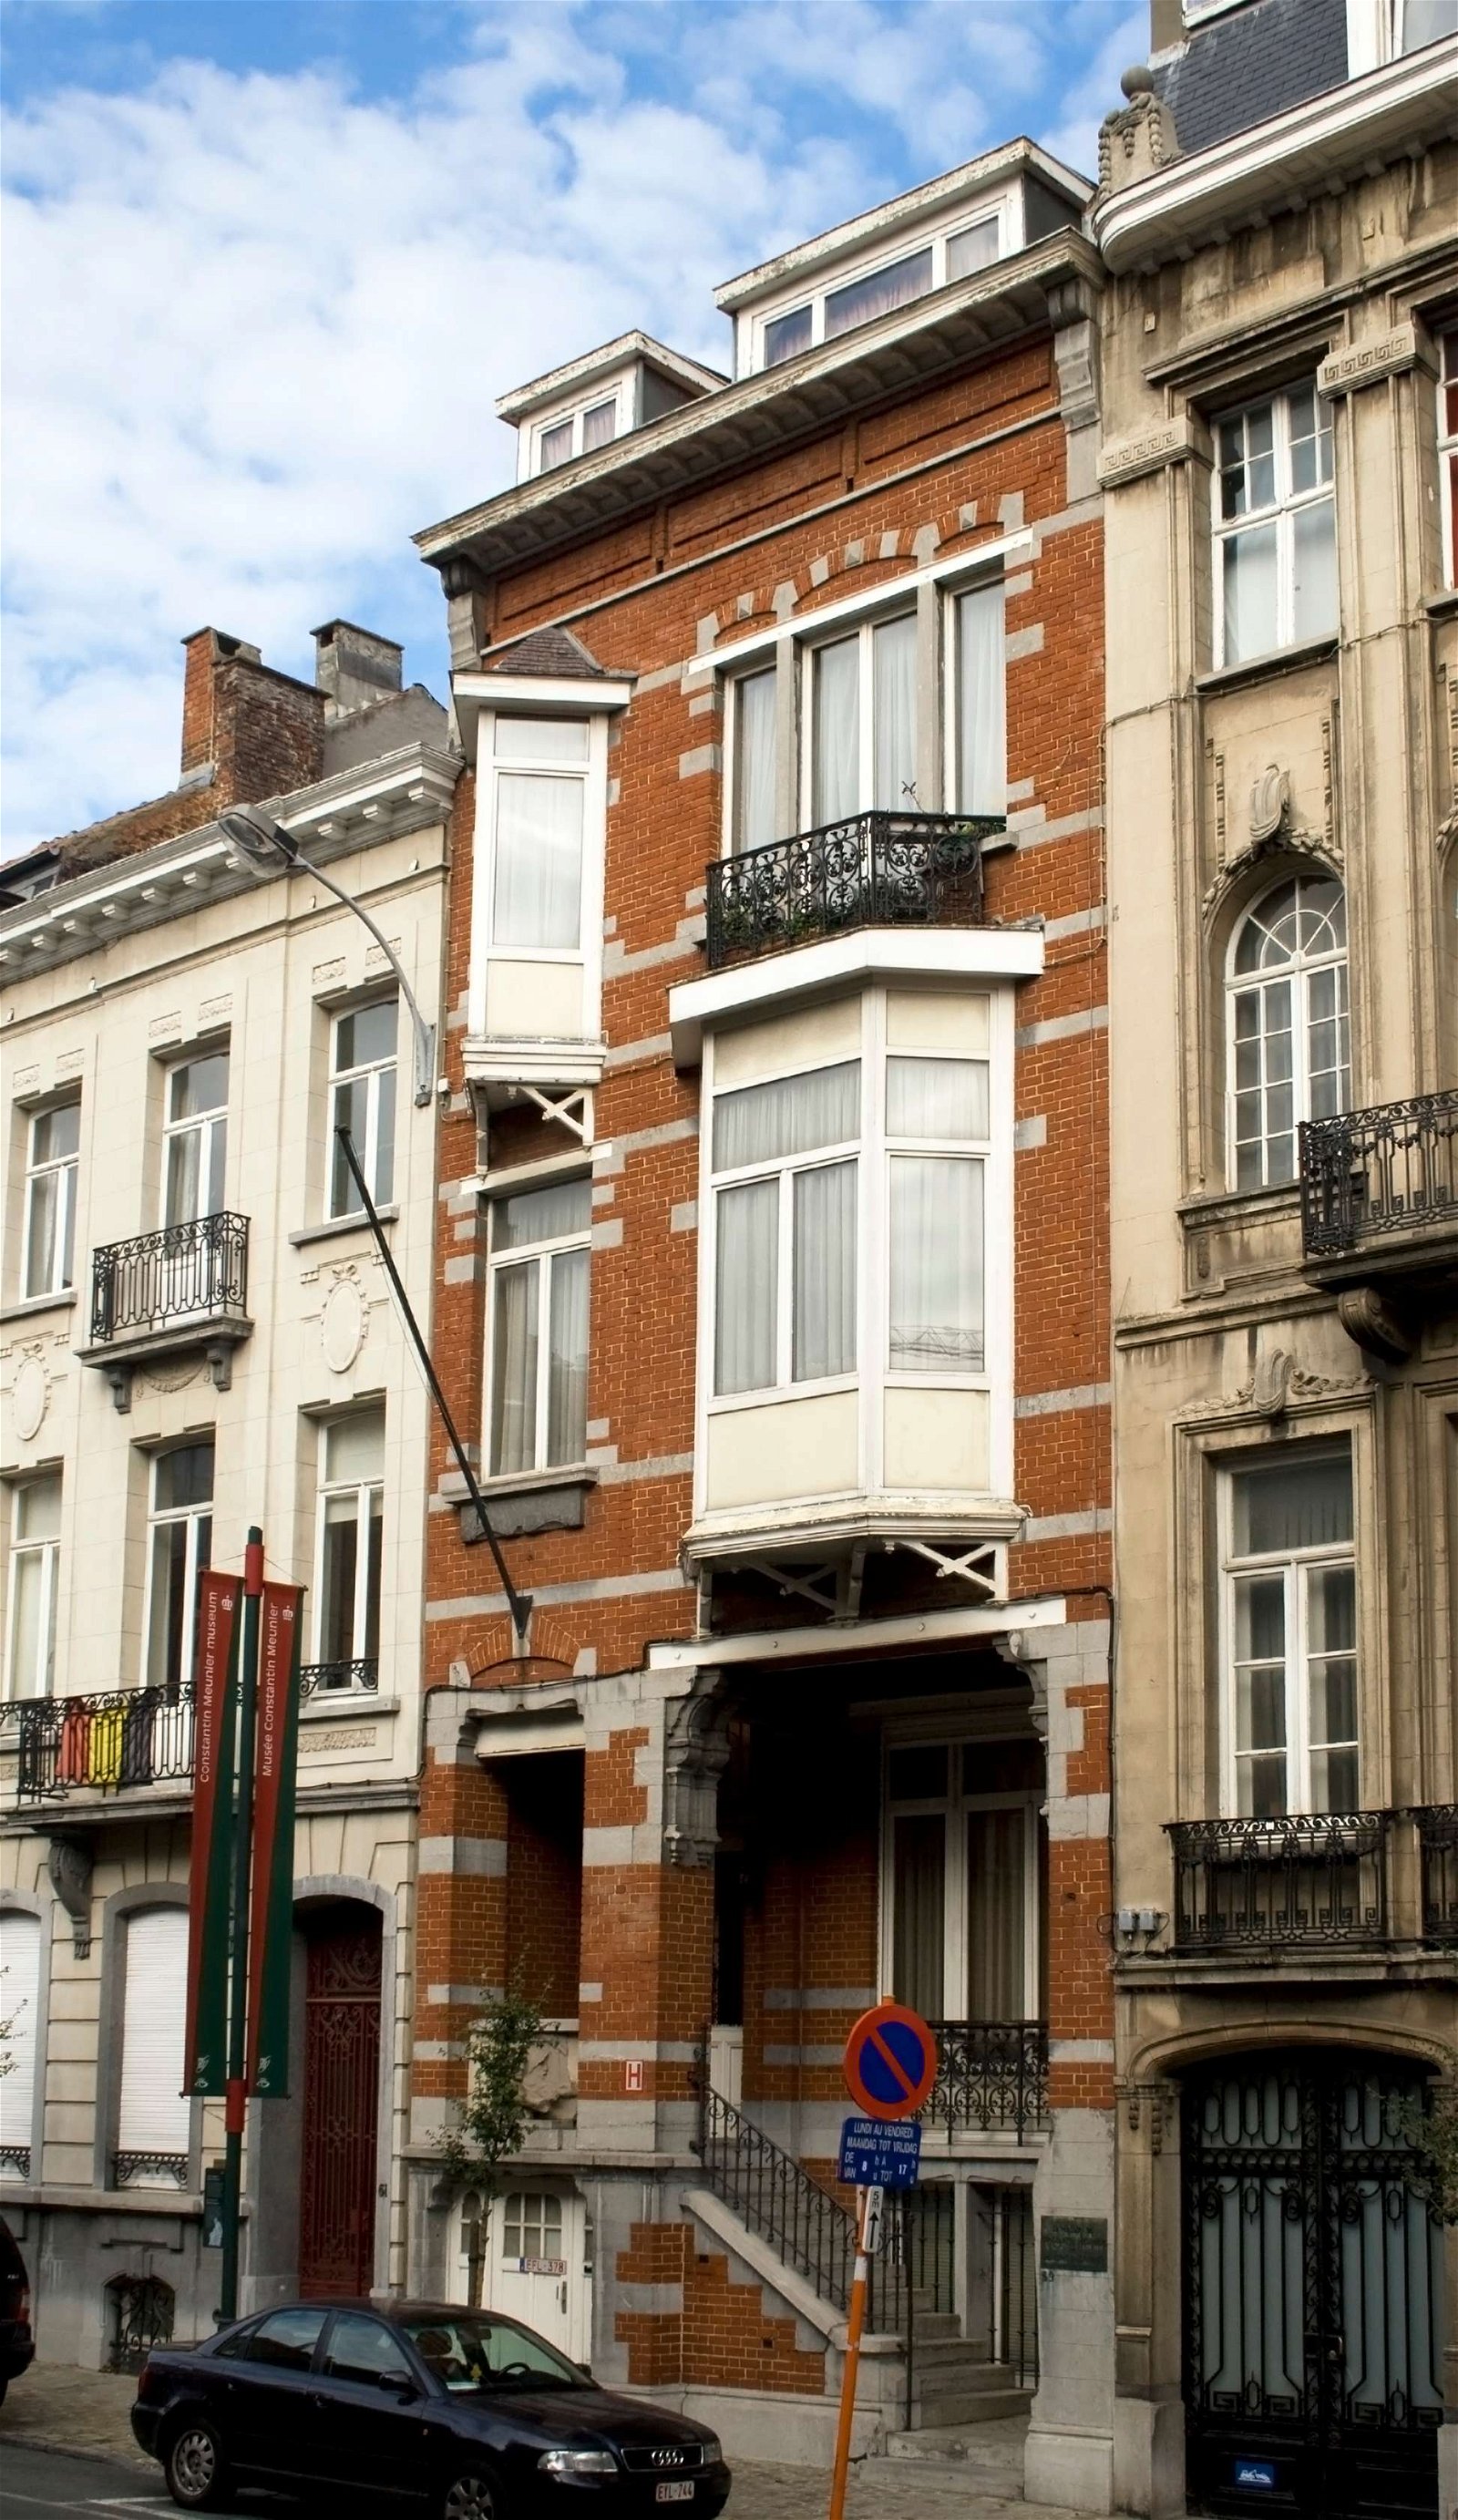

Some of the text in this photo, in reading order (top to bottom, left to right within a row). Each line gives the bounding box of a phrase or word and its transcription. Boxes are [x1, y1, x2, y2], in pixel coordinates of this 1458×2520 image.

[200, 1591, 218, 1783] Constantin Meunier museum
[262, 1602, 278, 1776] Musée Constantin Meunier
[628, 2062, 642, 2089] H
[855, 2123, 914, 2139] LUNDI AU VENDREDI
[847, 2137, 918, 2154] MAANDAG TOT VRIJDAG
[845, 2152, 855, 2164] DE
[844, 2167, 856, 2178] VAN
[862, 2161, 868, 2172] 8
[898, 2165, 908, 2175] 17
[880, 2171, 893, 2182] TOT
[873, 2191, 879, 2201] 5
